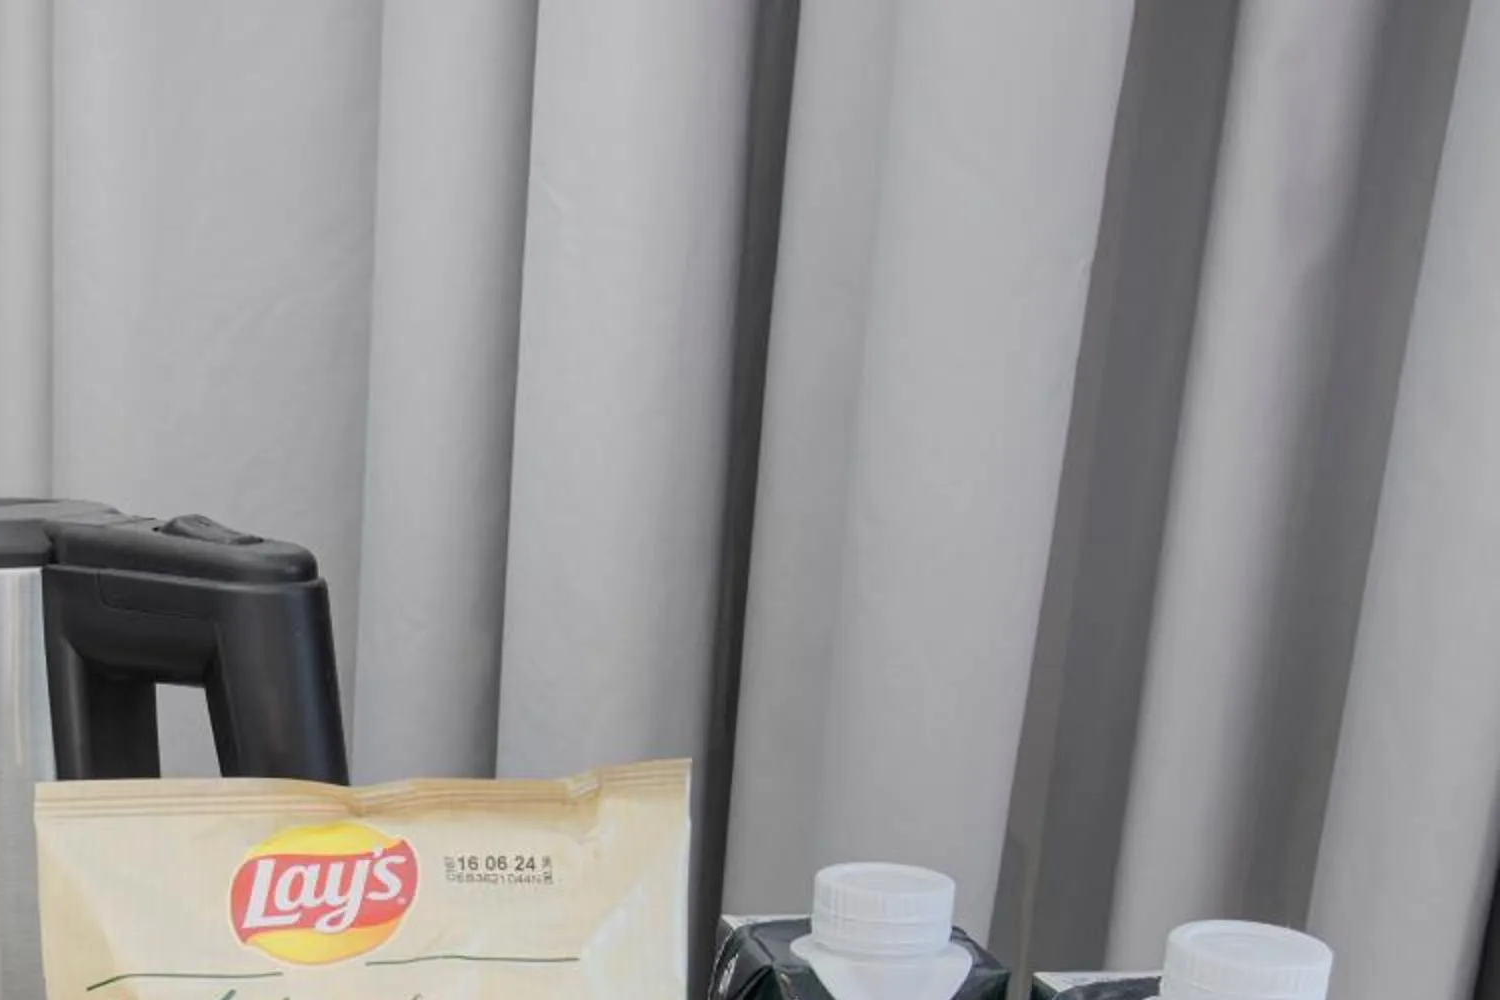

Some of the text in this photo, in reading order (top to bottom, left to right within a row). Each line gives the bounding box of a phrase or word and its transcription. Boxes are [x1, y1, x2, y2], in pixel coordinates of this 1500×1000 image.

[243, 845, 406, 933] Lay's
[457, 855, 479, 871] 16
[485, 855, 508, 871] 06
[514, 855, 536, 871] 24
